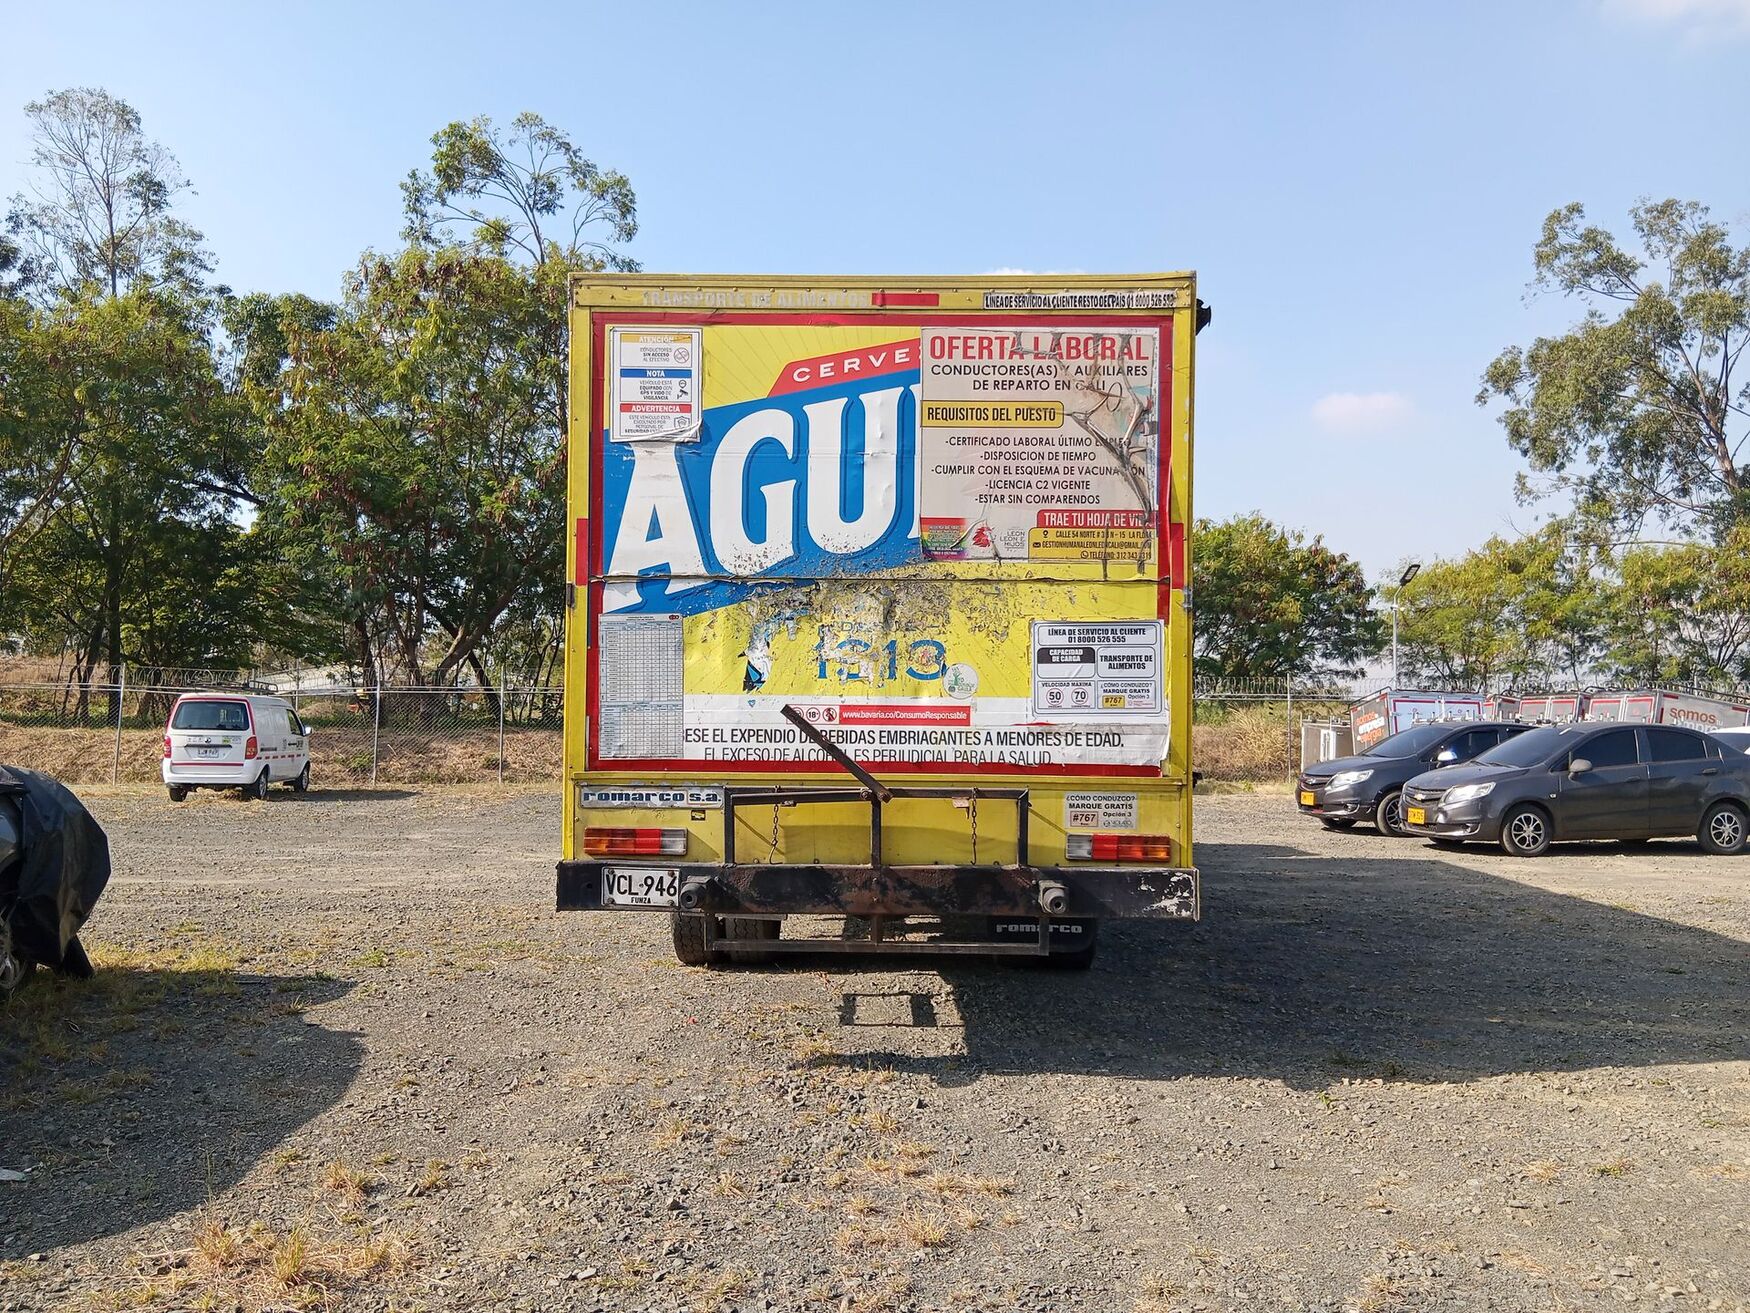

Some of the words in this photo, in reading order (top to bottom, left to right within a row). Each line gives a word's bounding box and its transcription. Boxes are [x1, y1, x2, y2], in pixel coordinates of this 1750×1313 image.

[1014, 295, 1042, 307] SERVICIO
[1052, 295, 1078, 308] CLIENTE
[1078, 295, 1098, 307] RESTO
[930, 336, 1022, 360] OFERTA
[1034, 336, 1149, 361] LABORAL
[792, 346, 921, 383] CERVE
[931, 364, 1058, 378] CONDUCTORES(AS)
[1075, 365, 1147, 376] AUXILIARES
[973, 380, 988, 390] DE
[993, 380, 1050, 390] REPARTO
[1054, 380, 1071, 390] EN
[1076, 380, 1105, 391] CALI
[928, 407, 989, 422] REQUISITOS
[992, 407, 1011, 422] DEL
[1015, 408, 1056, 422] PUESTO
[946, 436, 1010, 447] -CERTIFICADO
[1013, 437, 1055, 447] LABORAL
[1058, 434, 1092, 447] ÚLTIMO
[1048, 451, 1060, 461] DE
[1062, 451, 1096, 461] TIEMPO
[931, 465, 975, 475] -CUMPLIR
[978, 465, 1001, 475] CON
[1004, 465, 1012, 475] EL
[1015, 465, 1061, 476] ESQUEMA
[1064, 465, 1075, 475] DE
[1078, 464, 1145, 476] VACUNAÓN
[985, 480, 1032, 490] -LICENCIA
[1035, 480, 1049, 490] C2
[1052, 480, 1090, 490] VIGENTE
[602, 384, 920, 613] AGU
[975, 494, 1005, 504] -ESTAR
[1008, 494, 1023, 504] SIN
[1026, 494, 1100, 504] COMPARENDOS
[1044, 513, 1070, 526] TRAE
[1072, 513, 1084, 526] TU
[1087, 513, 1111, 526] HOJA
[1114, 513, 1126, 526] DE
[1129, 531, 1135, 539] LA
[1048, 628, 1066, 636] LÍNEA
[1049, 692, 1061, 700] 50
[1075, 691, 1086, 699] 70
[842, 711, 967, 721] www.bavaria.co/ConsumoResponsable
[1670, 707, 1716, 724] somos
[683, 729, 709, 743] ESE
[712, 729, 728, 743] EL
[731, 729, 796, 744] EXPENDIO
[822, 730, 875, 744] BEBIDAS
[879, 730, 981, 746] EMBRIAGANTES
[984, 732, 993, 745] A
[997, 732, 1061, 746] MENORES
[1066, 732, 1082, 747] DE
[1087, 732, 1124, 747] EDAD.
[705, 748, 718, 761] EL
[722, 748, 770, 761] EXCESO
[773, 748, 790, 761] DE
[793, 748, 849, 762] ALCOHL
[854, 749, 870, 762] ES
[954, 750, 987, 765] PARA
[991, 750, 1005, 763] LA
[583, 792, 685, 801] romarco
[689, 793, 721, 801] s.a.
[1073, 814, 1096, 822] #767
[996, 924, 1083, 933] romrco
